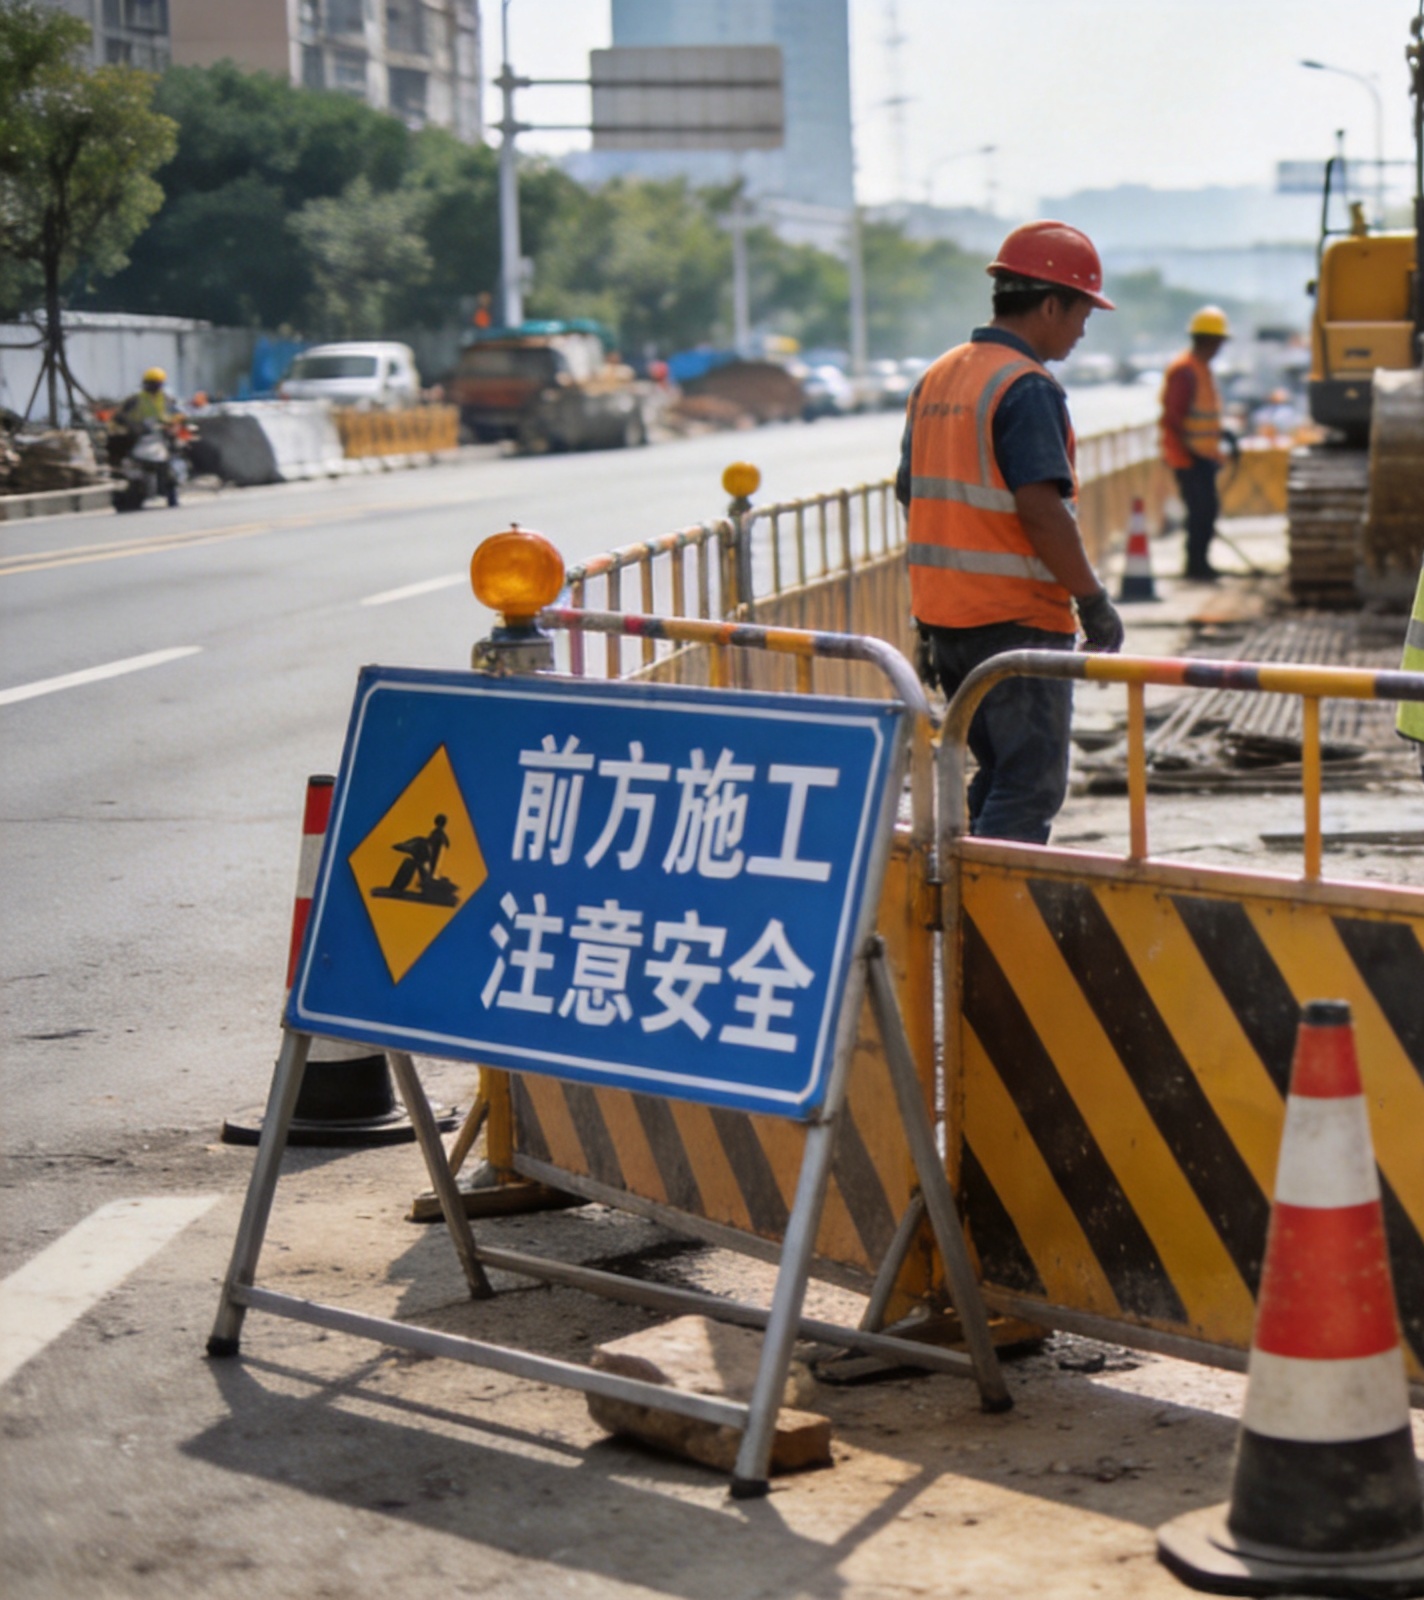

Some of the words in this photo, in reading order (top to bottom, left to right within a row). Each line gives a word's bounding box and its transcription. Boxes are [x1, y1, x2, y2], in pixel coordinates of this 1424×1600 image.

[511, 734, 840, 882] 前方施工
[480, 892, 815, 1053] 注意安全
